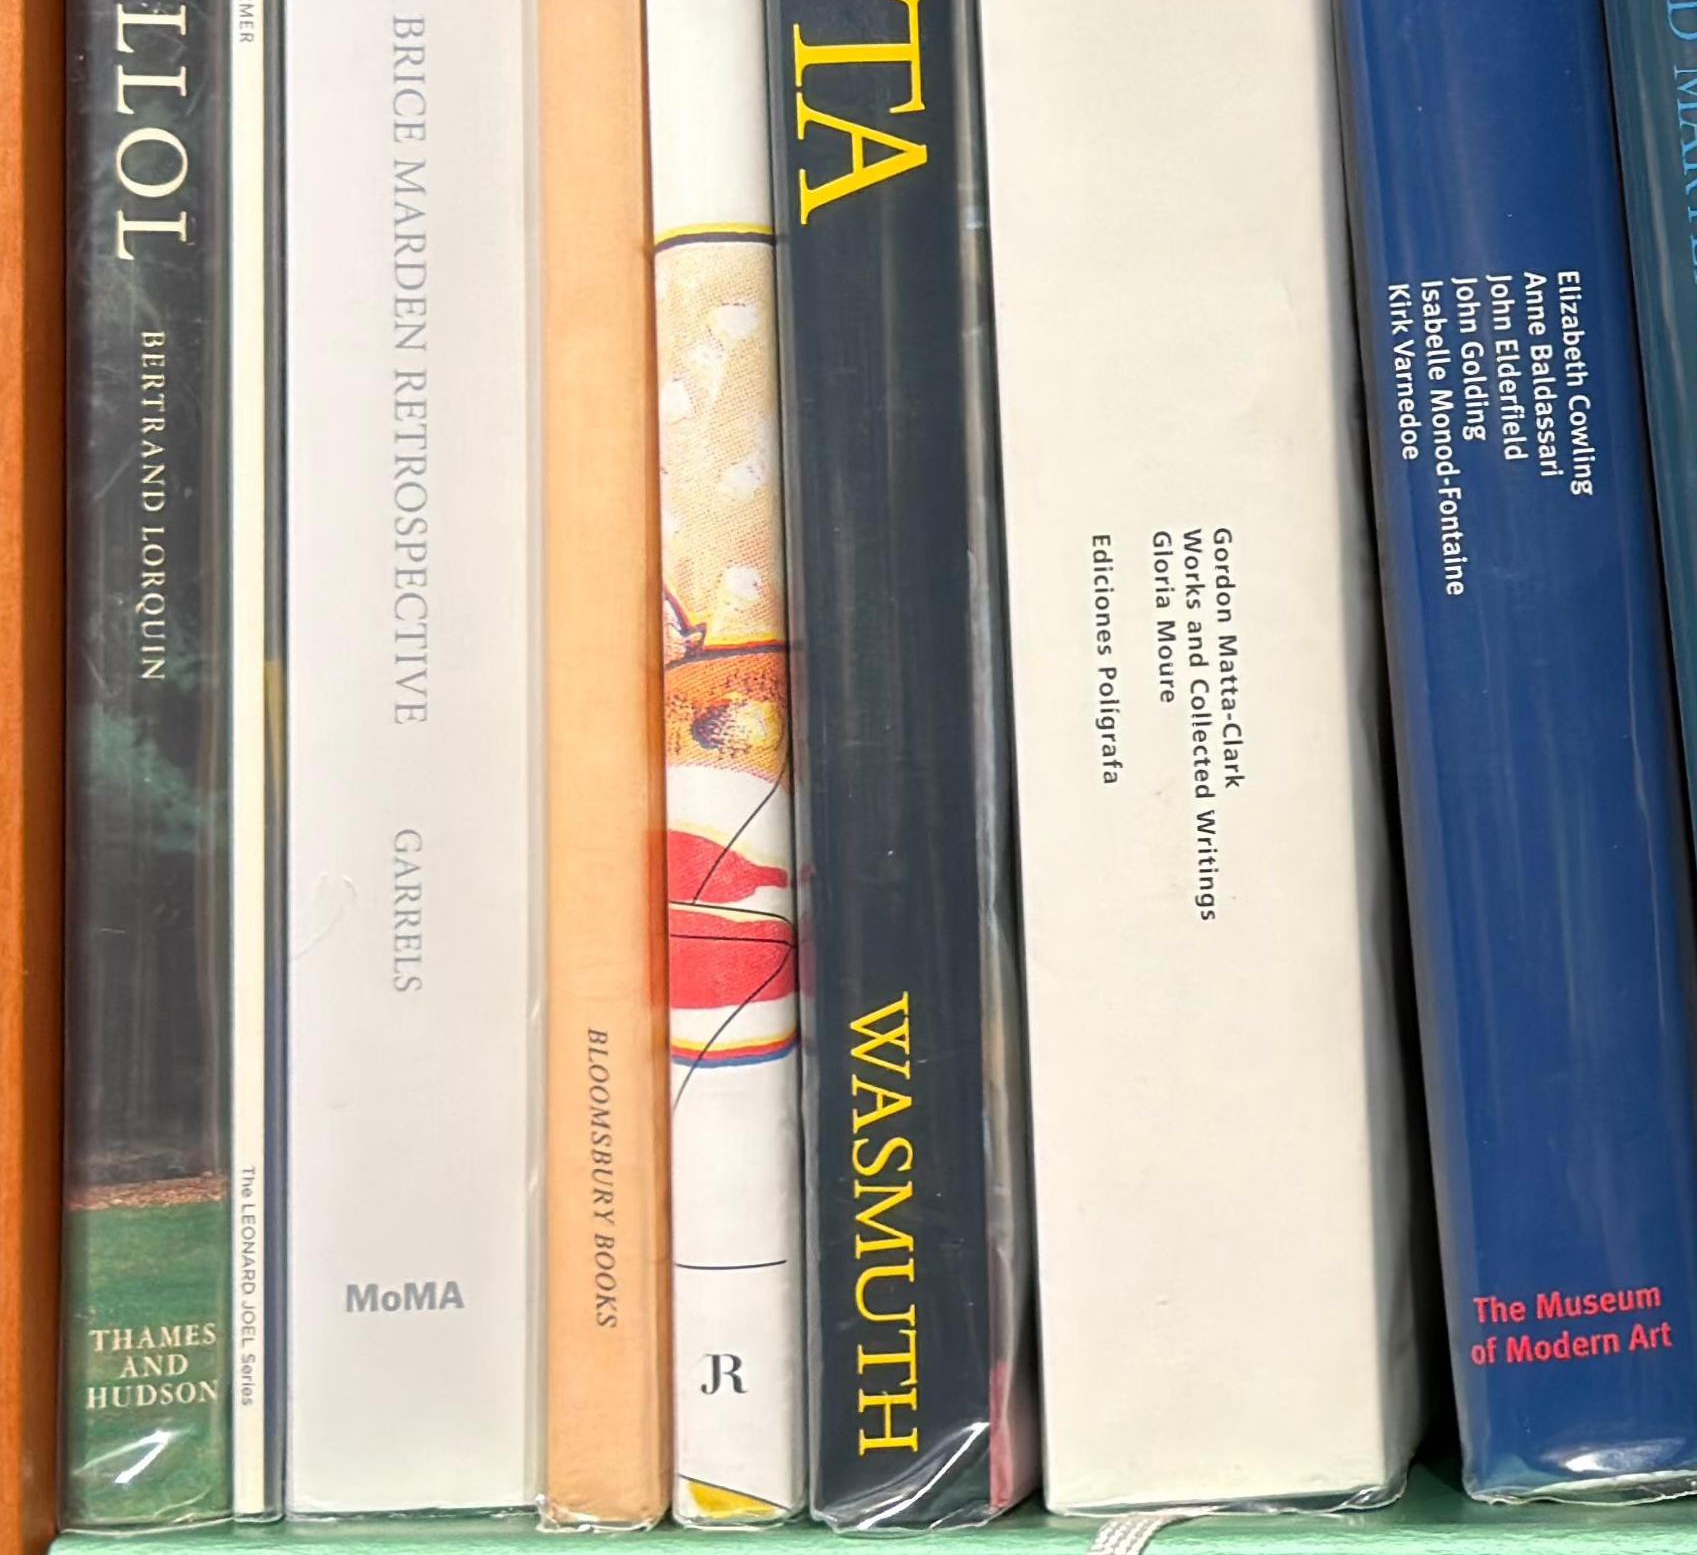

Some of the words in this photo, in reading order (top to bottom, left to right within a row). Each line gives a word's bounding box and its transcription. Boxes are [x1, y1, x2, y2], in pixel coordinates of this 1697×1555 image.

[392, 15, 428, 146] BRICE
[393, 159, 428, 352] MARDEN
[1451, 275, 1481, 334] John
[1486, 272, 1515, 332] John
[1522, 270, 1548, 337] Anne
[1386, 282, 1413, 336] Kirk
[1420, 280, 1448, 382] Isabelle
[1556, 269, 1590, 385] Elizabeth
[140, 330, 166, 514] BERTRAND
[1391, 338, 1422, 461] Varnedoe
[1460, 341, 1491, 442] Golding
[1494, 339, 1529, 462] Elderfield
[1528, 343, 1564, 478] Baldassari
[1429, 388, 1469, 596] Monod-Fontaine
[1567, 393, 1597, 496] Cowling
[394, 368, 429, 726] RETROSPECTIVE
[1091, 534, 1114, 656] Ediciones
[1152, 530, 1172, 610] Gloria
[1182, 527, 1203, 610] Works
[1212, 526, 1234, 623] Gordon
[135, 525, 166, 682] LORQUIN
[1186, 620, 1209, 668] and
[1155, 619, 1176, 705] Moure
[1217, 634, 1245, 790] Matta-Clark
[1095, 666, 1124, 786] Polígrafa
[1188, 679, 1216, 799] Collected
[393, 828, 423, 993] GARRELS
[1194, 809, 1219, 922] Writings
[586, 1028, 616, 1224] BLOOMSBURY
[241, 1165, 257, 1199] The
[849, 991, 919, 1456] WASMUTH
[241, 1203, 257, 1295] LEONARD
[345, 1280, 465, 1314] MoMA
[593, 1232, 618, 1329] BOOKS
[90, 1324, 217, 1352] THAMES
[241, 1301, 257, 1349] JOEL
[1470, 1335, 1498, 1365] of
[1505, 1327, 1621, 1364] Modern
[1628, 1322, 1672, 1351] Art
[1473, 1295, 1526, 1326] The
[1535, 1284, 1662, 1321] Museum
[86, 1378, 218, 1410] HUDSON
[120, 1354, 189, 1378] AND
[241, 1353, 257, 1407] Series
